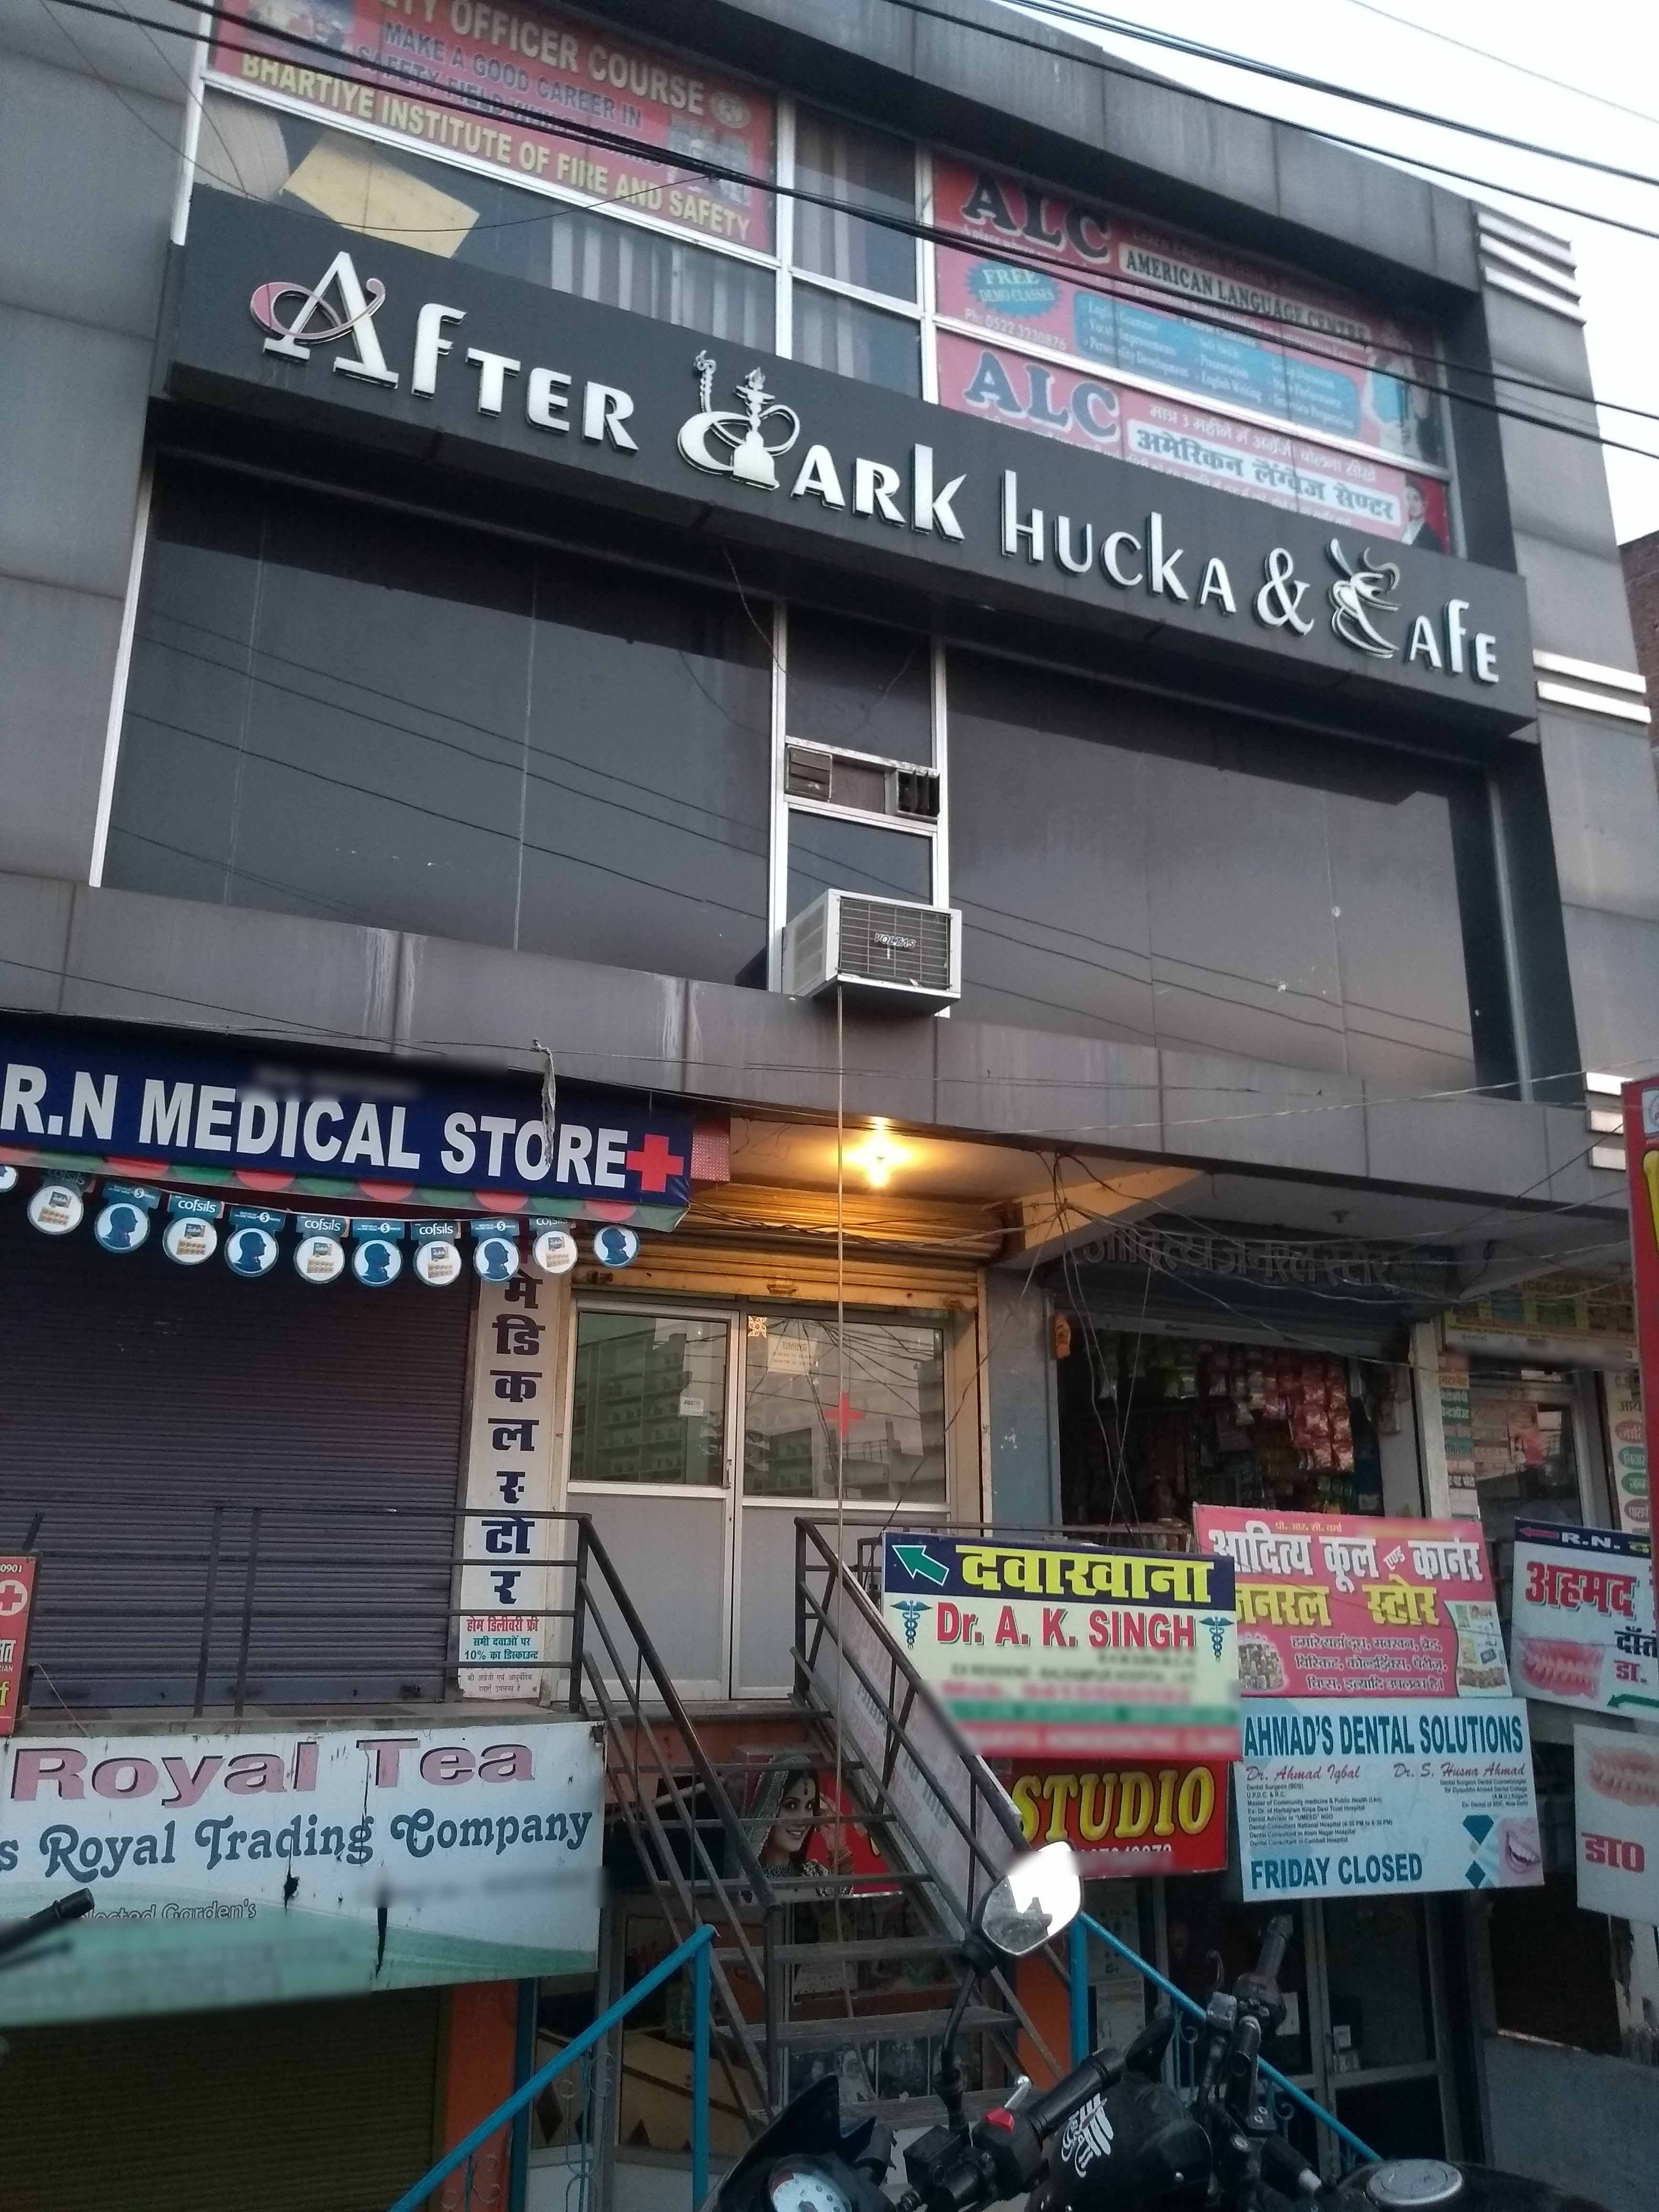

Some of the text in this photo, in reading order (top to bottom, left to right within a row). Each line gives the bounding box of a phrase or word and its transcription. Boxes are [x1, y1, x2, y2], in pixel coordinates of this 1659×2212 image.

[385, 21, 445, 62] MAKE
[451, 46, 465, 68] A
[470, 53, 529, 93] GOOD
[536, 76, 616, 121] CAREER
[622, 107, 640, 128] IN
[451, 0, 579, 73] OFFICER
[588, 45, 705, 115] COURSE
[242, 53, 375, 119] BHARTIYE
[382, 96, 511, 164] INSTITUTE
[519, 141, 550, 173] OF
[615, 172, 662, 211] AND
[670, 190, 752, 240] SAFETY
[960, 173, 1112, 264] ALC
[979, 288, 1009, 302] DEMO
[982, 268, 1040, 286] FREE
[1126, 250, 1212, 295] AMERICAN
[1218, 279, 1302, 321] LANGUAGE
[963, 350, 1121, 443] ALC
[1137, 428, 1244, 478] अमेरिकन
[1254, 547, 1314, 636] &
[874, 933, 916, 948] VOLTAS
[1, 1063, 118, 1140] R.N
[139, 1078, 420, 1170] MEDICAL
[441, 1112, 628, 1189] STORE
[178, 1199, 216, 1213] cofsils
[305, 1218, 341, 1232] cofsils
[419, 1223, 453, 1236] cofsils
[782, 1340, 807, 1349] TIMING
[1208, 1520, 1314, 1576] आदित्य
[1319, 1535, 1380, 1594] कूल
[1561, 1532, 1621, 1549] R.N.
[956, 1545, 1214, 1603] दवाखाना
[1524, 1561, 1639, 1621] अहमद
[1361, 1574, 1439, 1626] स्टोर
[521, 1637, 531, 1646] पर
[936, 1602, 1196, 1651] Dr. A. K. SINGH
[464, 1650, 486, 1660] 10%
[489, 1651, 501, 1659] का
[1244, 1714, 1334, 1756] AHMAD'S
[1340, 1715, 1416, 1755] DENTAL
[1419, 1715, 1524, 1755] SOLUTIONS
[11, 1737, 535, 1808] Royal Tea
[1245, 1766, 1268, 1781] Dr.
[1274, 1765, 1322, 1782] Ahmad
[1393, 1761, 1414, 1777] Dr.
[1421, 1762, 1434, 1777] S.
[1483, 1761, 1525, 1777] Ahmad
[1011, 1766, 1215, 1843] STUDIO
[39, 1819, 177, 1883] Royal
[194, 1814, 374, 1871] Trading
[390, 1808, 593, 1858] Company
[1251, 1852, 1423, 1890] FRIDAY CLOSED
